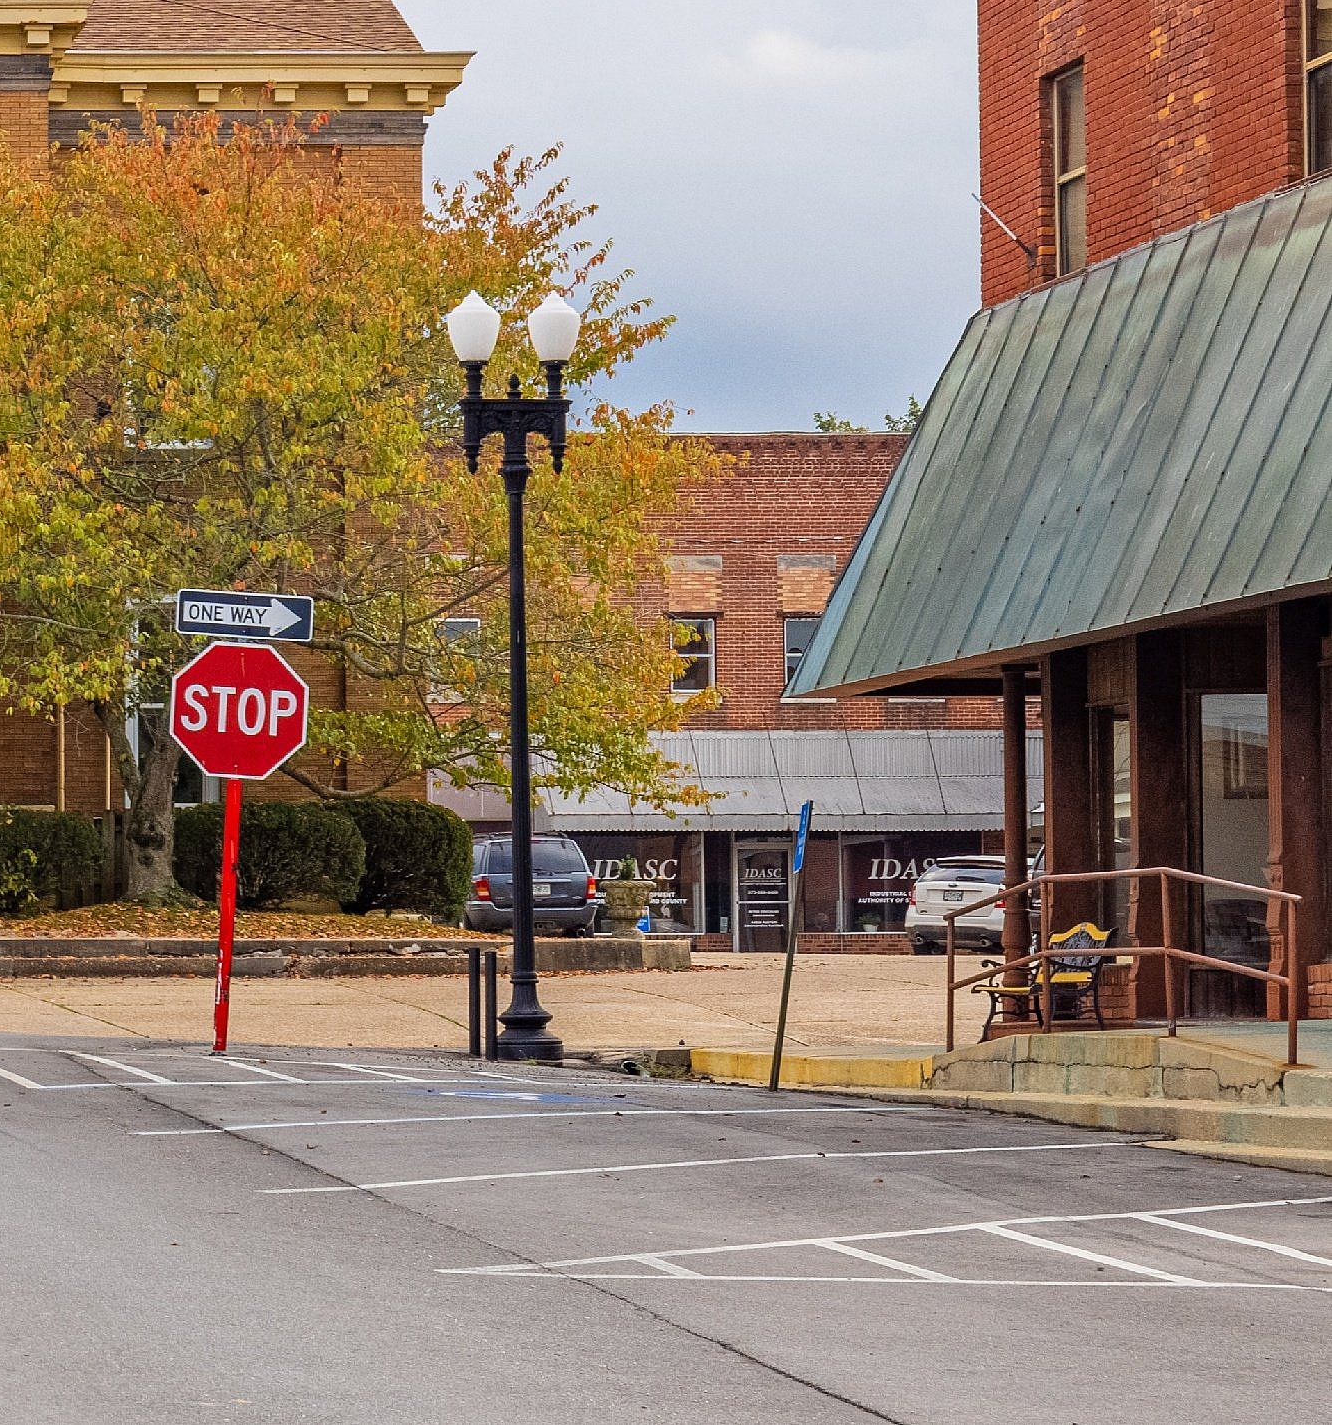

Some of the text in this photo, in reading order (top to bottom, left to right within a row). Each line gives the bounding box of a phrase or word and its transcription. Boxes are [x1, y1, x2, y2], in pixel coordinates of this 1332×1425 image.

[188, 604, 268, 624] ONE WAY
[180, 683, 298, 737] STOP
[744, 868, 782, 878] IDASC
[867, 858, 936, 880] IDAS
